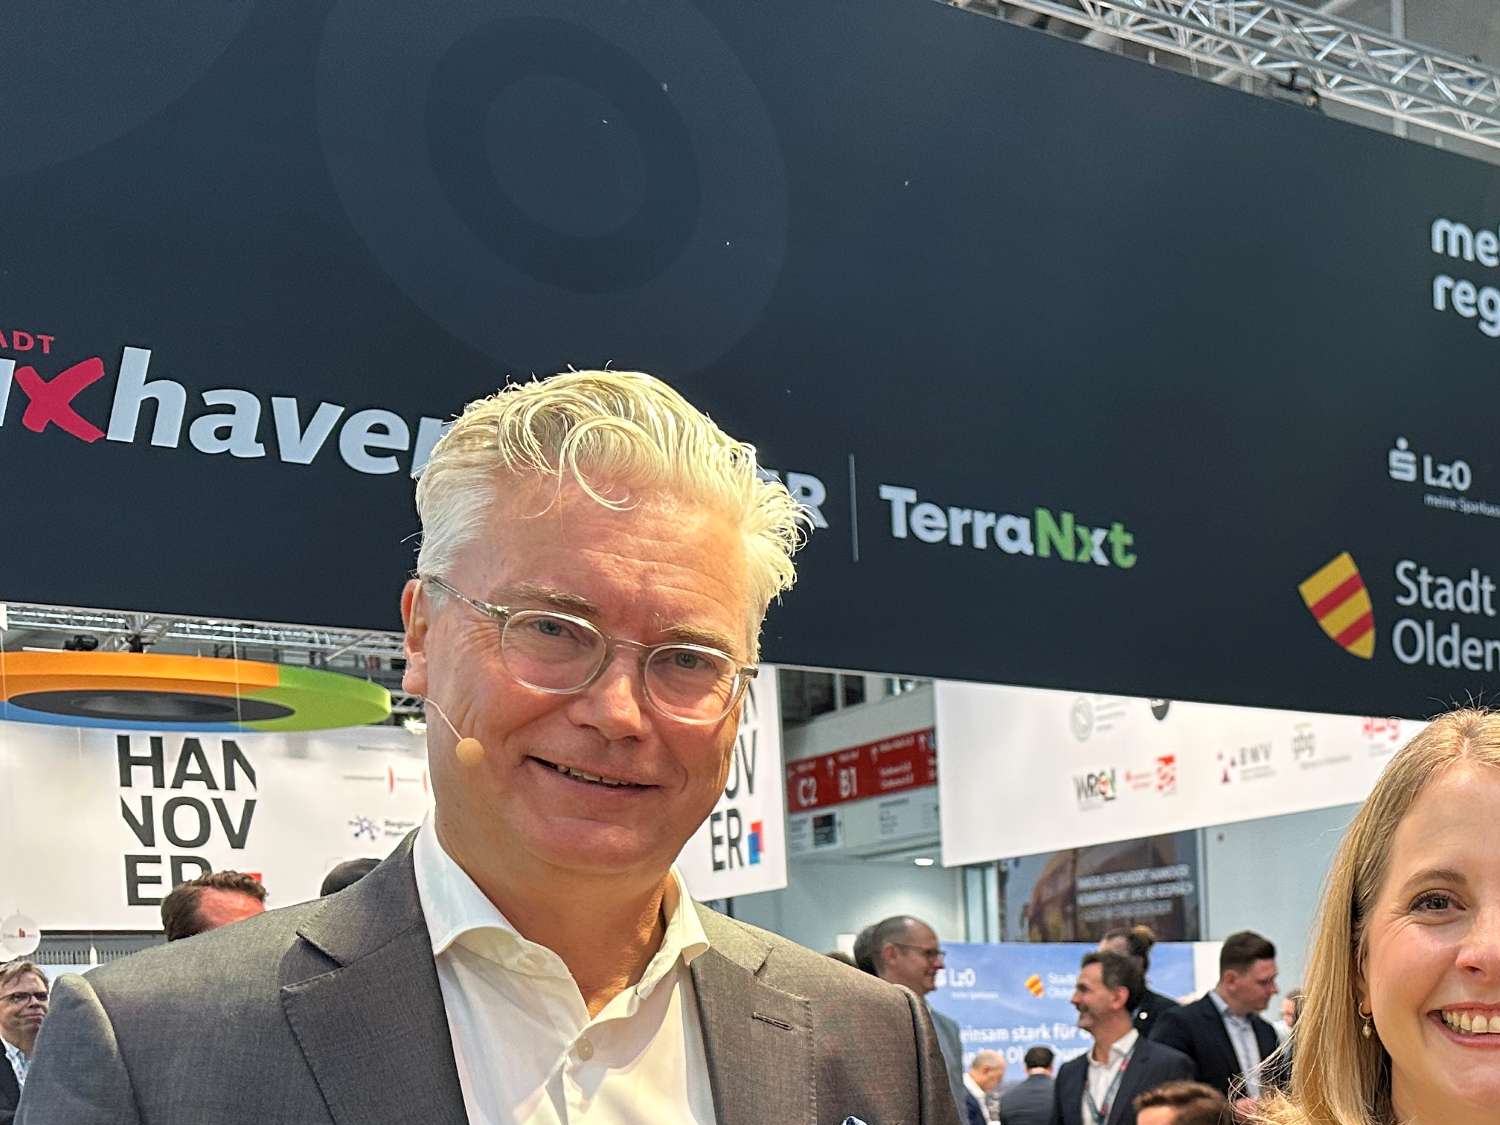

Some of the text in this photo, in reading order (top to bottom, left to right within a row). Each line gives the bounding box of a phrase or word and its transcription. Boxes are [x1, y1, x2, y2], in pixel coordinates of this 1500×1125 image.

[1423, 455, 1472, 491] LzO
[879, 484, 1137, 568] TerraNxt
[1395, 560, 1496, 616] Stadt
[116, 734, 258, 791] HAN
[120, 795, 257, 849] NOV
[711, 808, 744, 871] ER
[960, 1025, 1009, 1042] einsam
